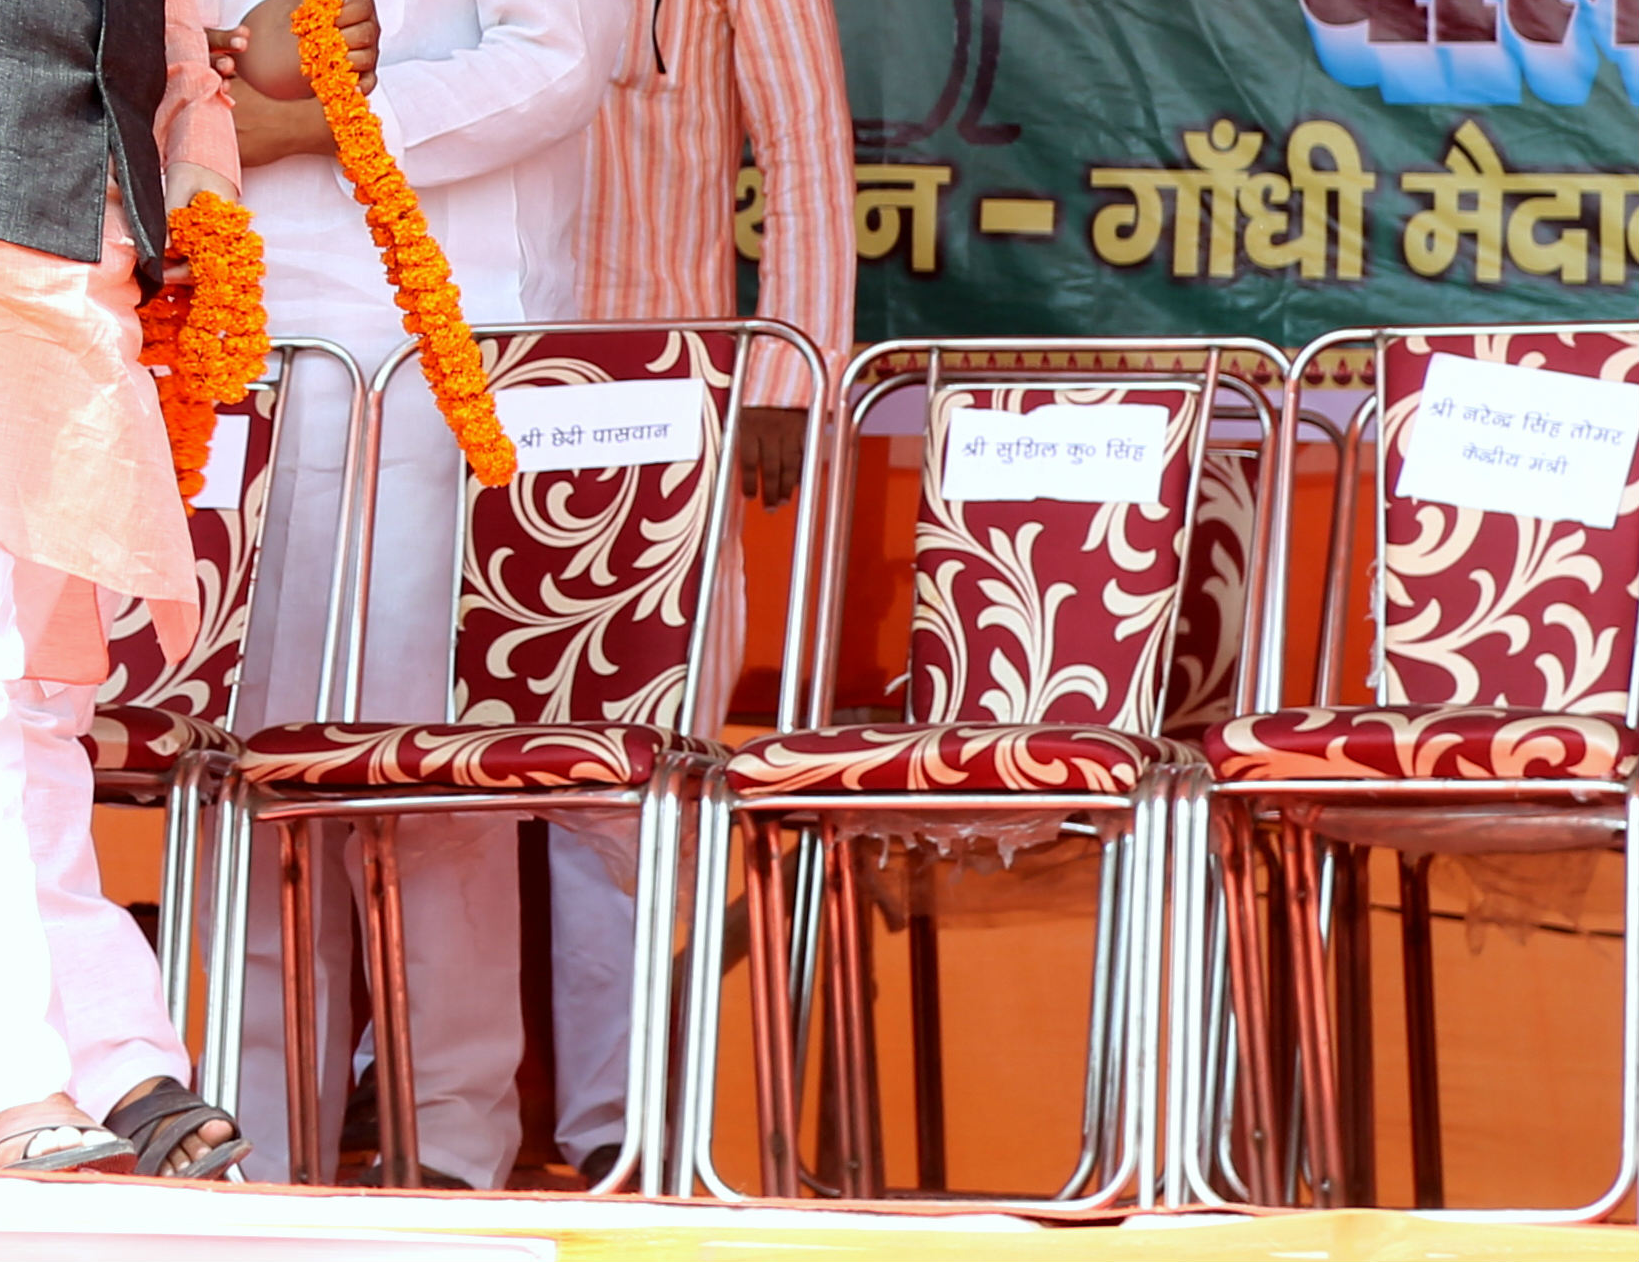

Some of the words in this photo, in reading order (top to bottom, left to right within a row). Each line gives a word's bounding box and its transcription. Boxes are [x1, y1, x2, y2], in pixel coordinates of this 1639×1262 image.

[1090, 118, 1376, 280] गाँधी
[1401, 118, 1639, 284] मैदा
[1429, 398, 1455, 418] श्री
[1462, 404, 1514, 429] नरेन्द्र
[1522, 412, 1562, 438] सिंह
[1570, 420, 1624, 446] तोमर
[519, 426, 544, 448] श्री
[552, 424, 585, 447] छेदी
[592, 423, 670, 444] पासवान
[963, 435, 988, 457] श्री
[1106, 437, 1145, 461] सिंह
[1529, 452, 1568, 476] मंत्री
